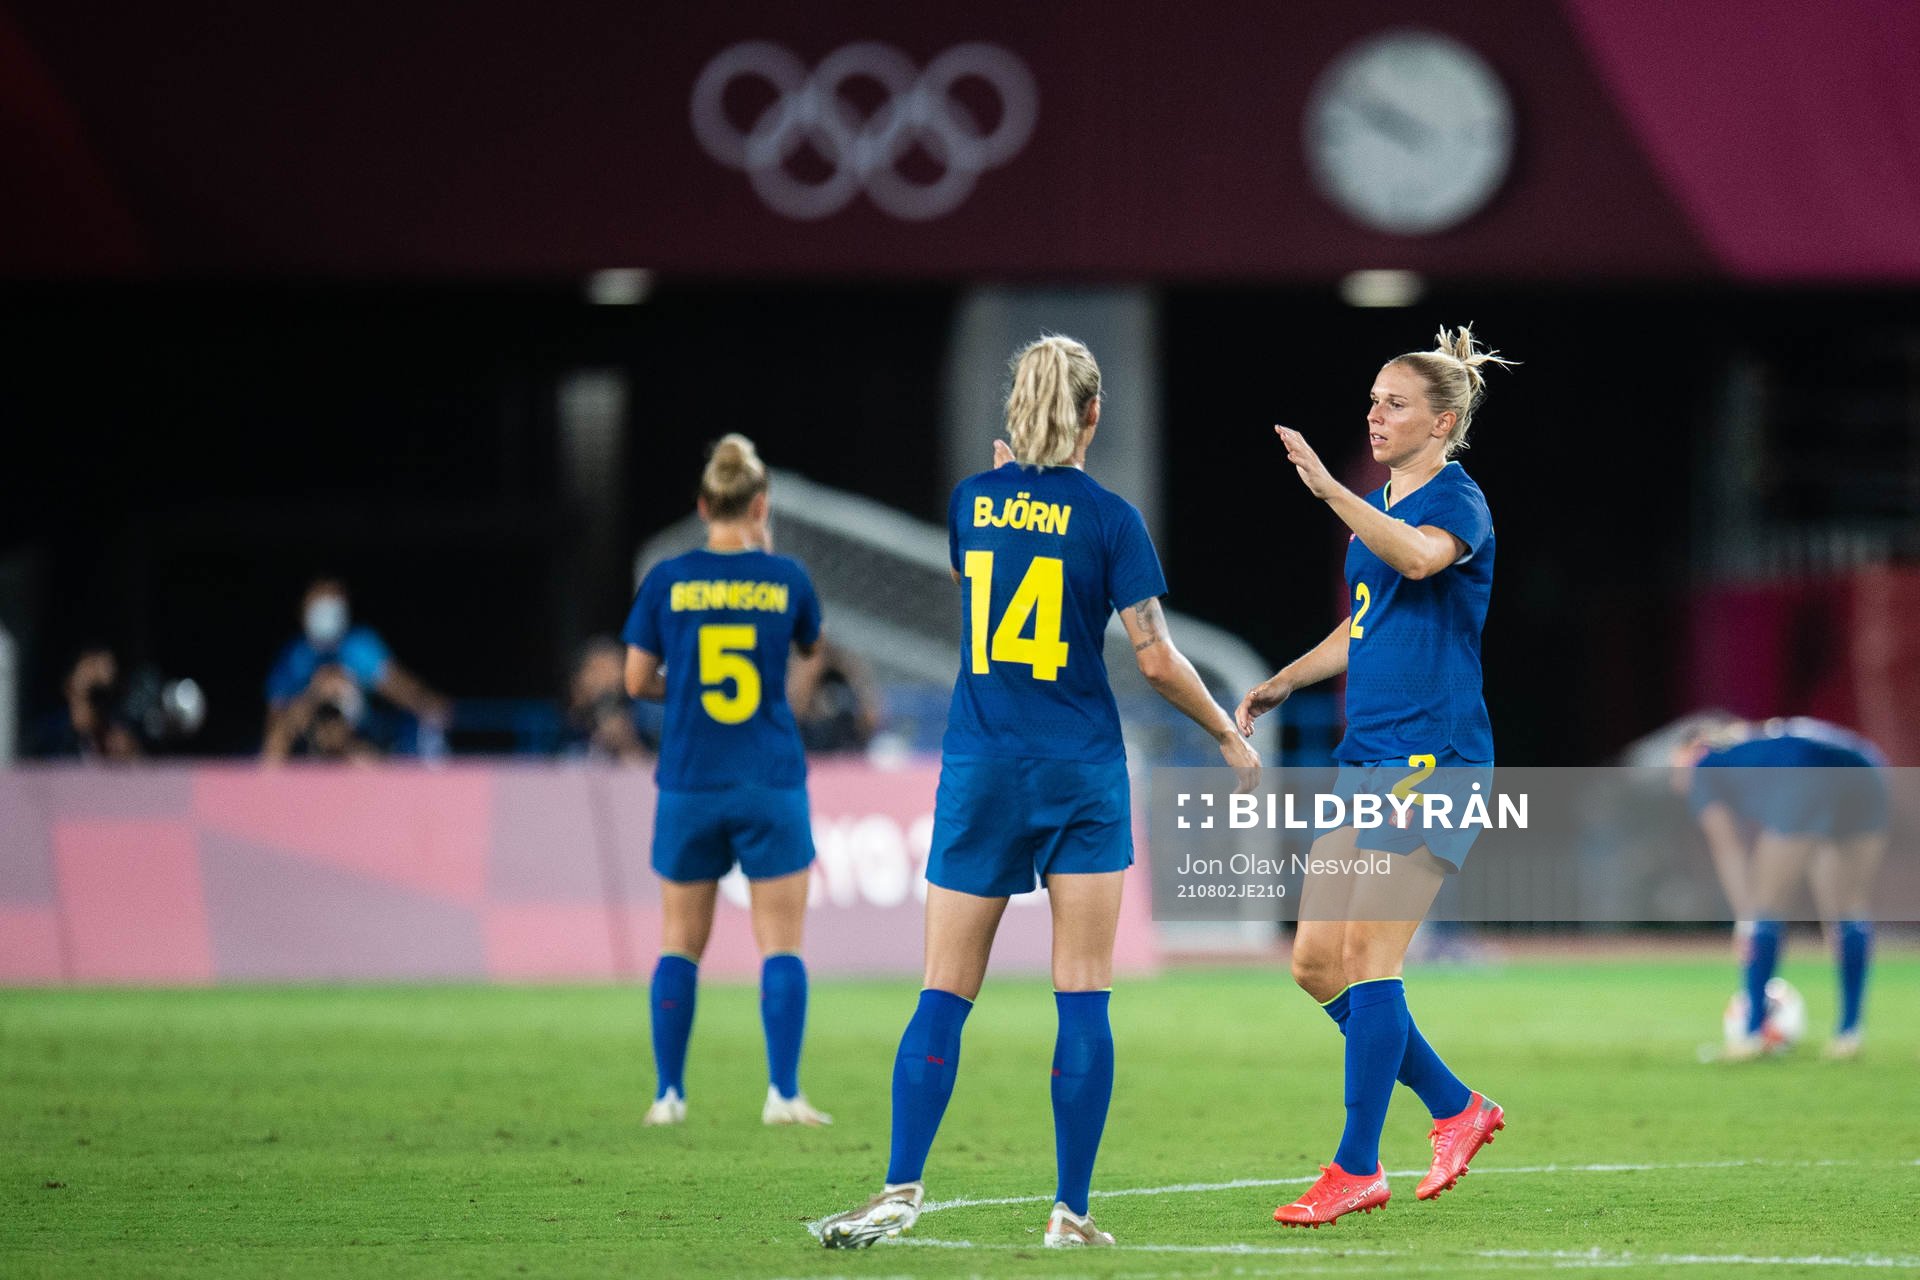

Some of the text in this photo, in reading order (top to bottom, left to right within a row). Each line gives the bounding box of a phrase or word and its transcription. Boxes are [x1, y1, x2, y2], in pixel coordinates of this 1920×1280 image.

[973, 491, 1072, 536] BJÖRN
[670, 580, 789, 613] BENNISON
[964, 550, 1069, 682] 14
[1350, 581, 1371, 639] 2
[698, 624, 762, 725] 5
[1390, 753, 1437, 807] 2
